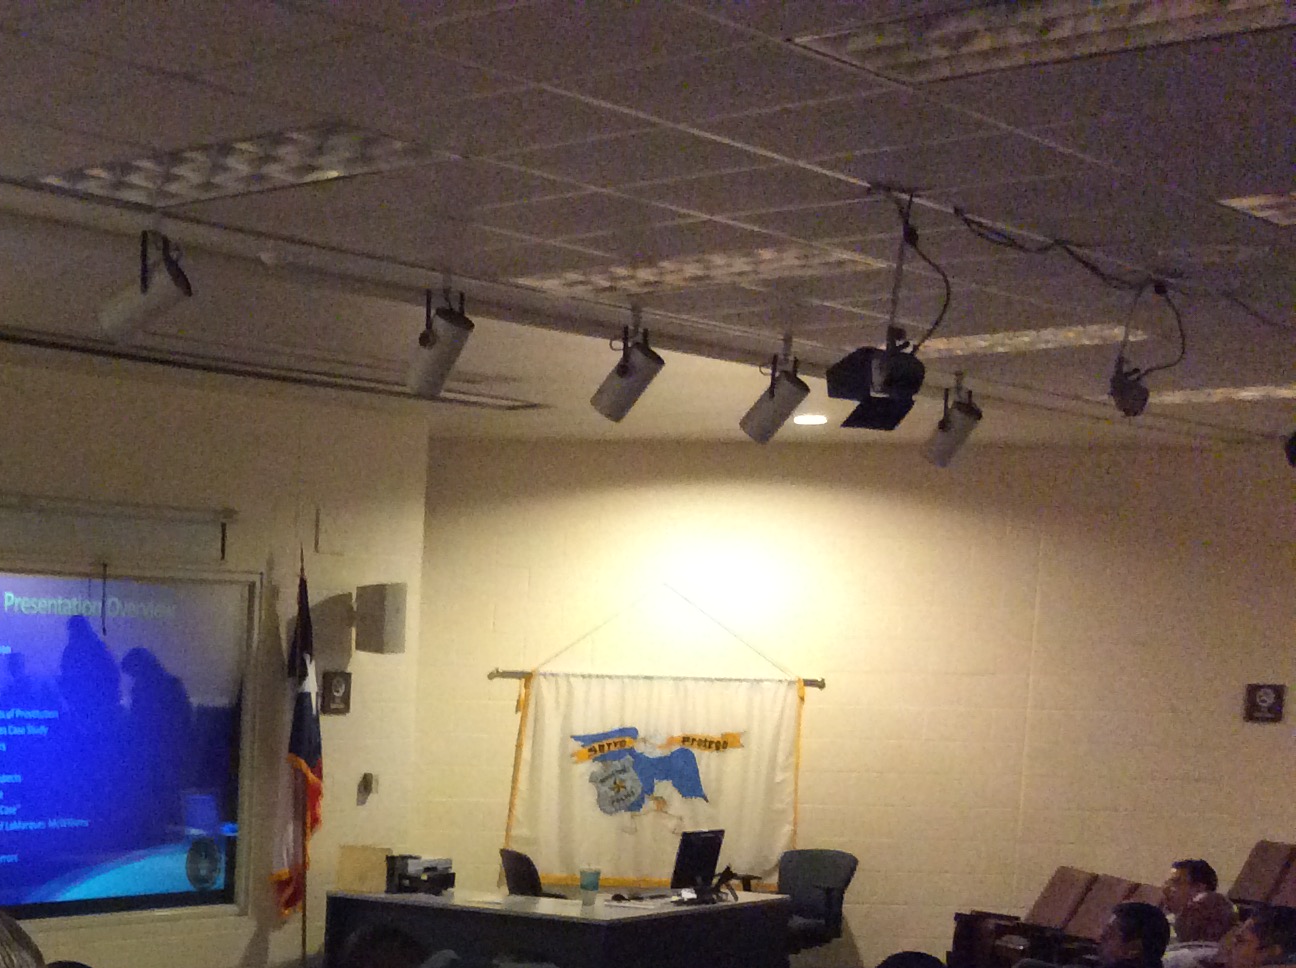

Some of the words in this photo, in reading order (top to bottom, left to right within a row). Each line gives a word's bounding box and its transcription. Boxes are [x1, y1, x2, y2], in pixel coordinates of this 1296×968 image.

[5, 591, 102, 616] Presentation
[6, 708, 15, 719] of
[15, 708, 59, 719] Prostitution
[7, 725, 26, 735] Case
[26, 724, 50, 736] Study
